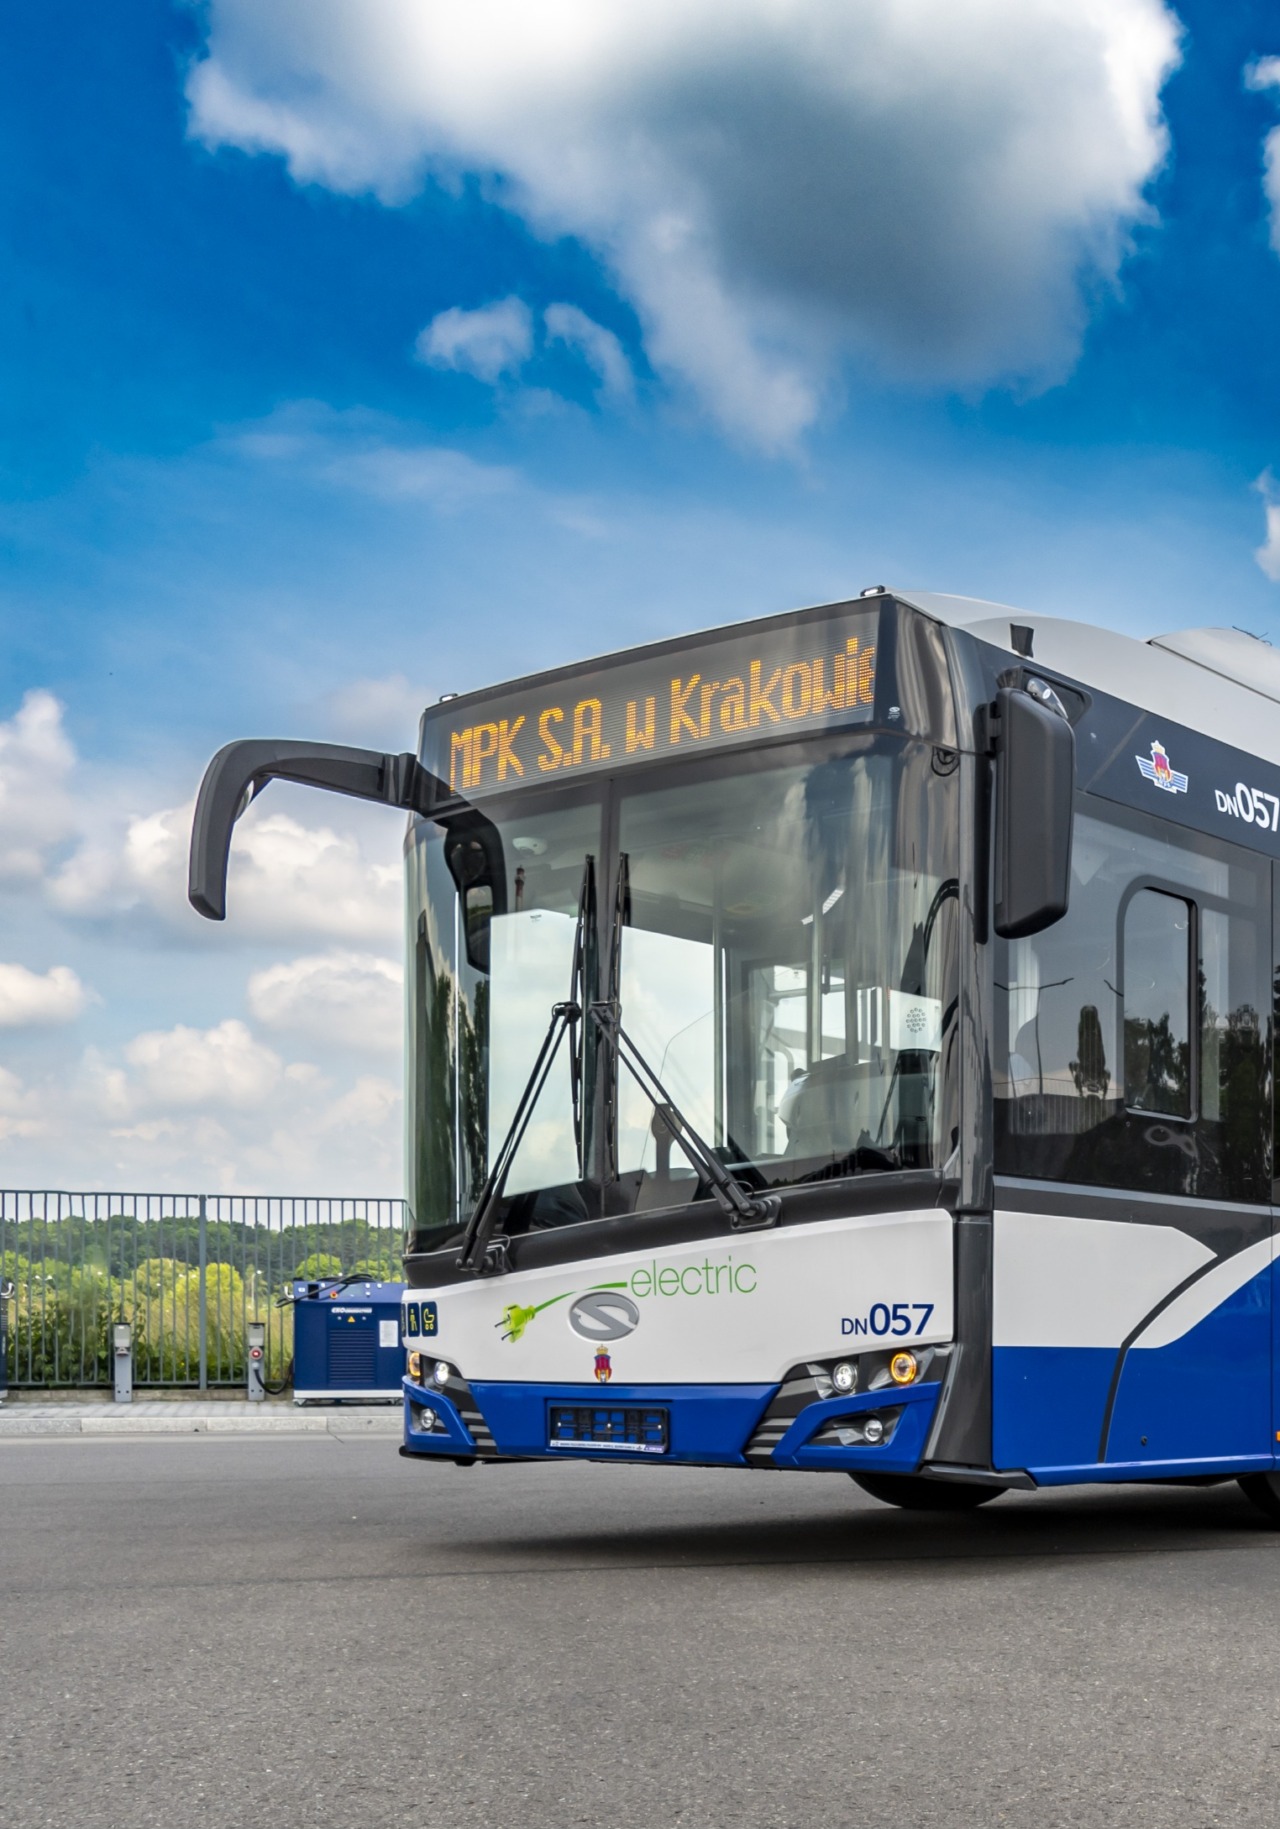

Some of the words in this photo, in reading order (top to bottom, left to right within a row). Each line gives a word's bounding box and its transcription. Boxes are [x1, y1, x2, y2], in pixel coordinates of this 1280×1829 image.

[450, 715, 525, 793] MPK
[537, 697, 611, 772] S.A.
[1214, 782, 1280, 832] DN057
[630, 1254, 758, 1299] electric
[841, 1303, 935, 1337] DN057
